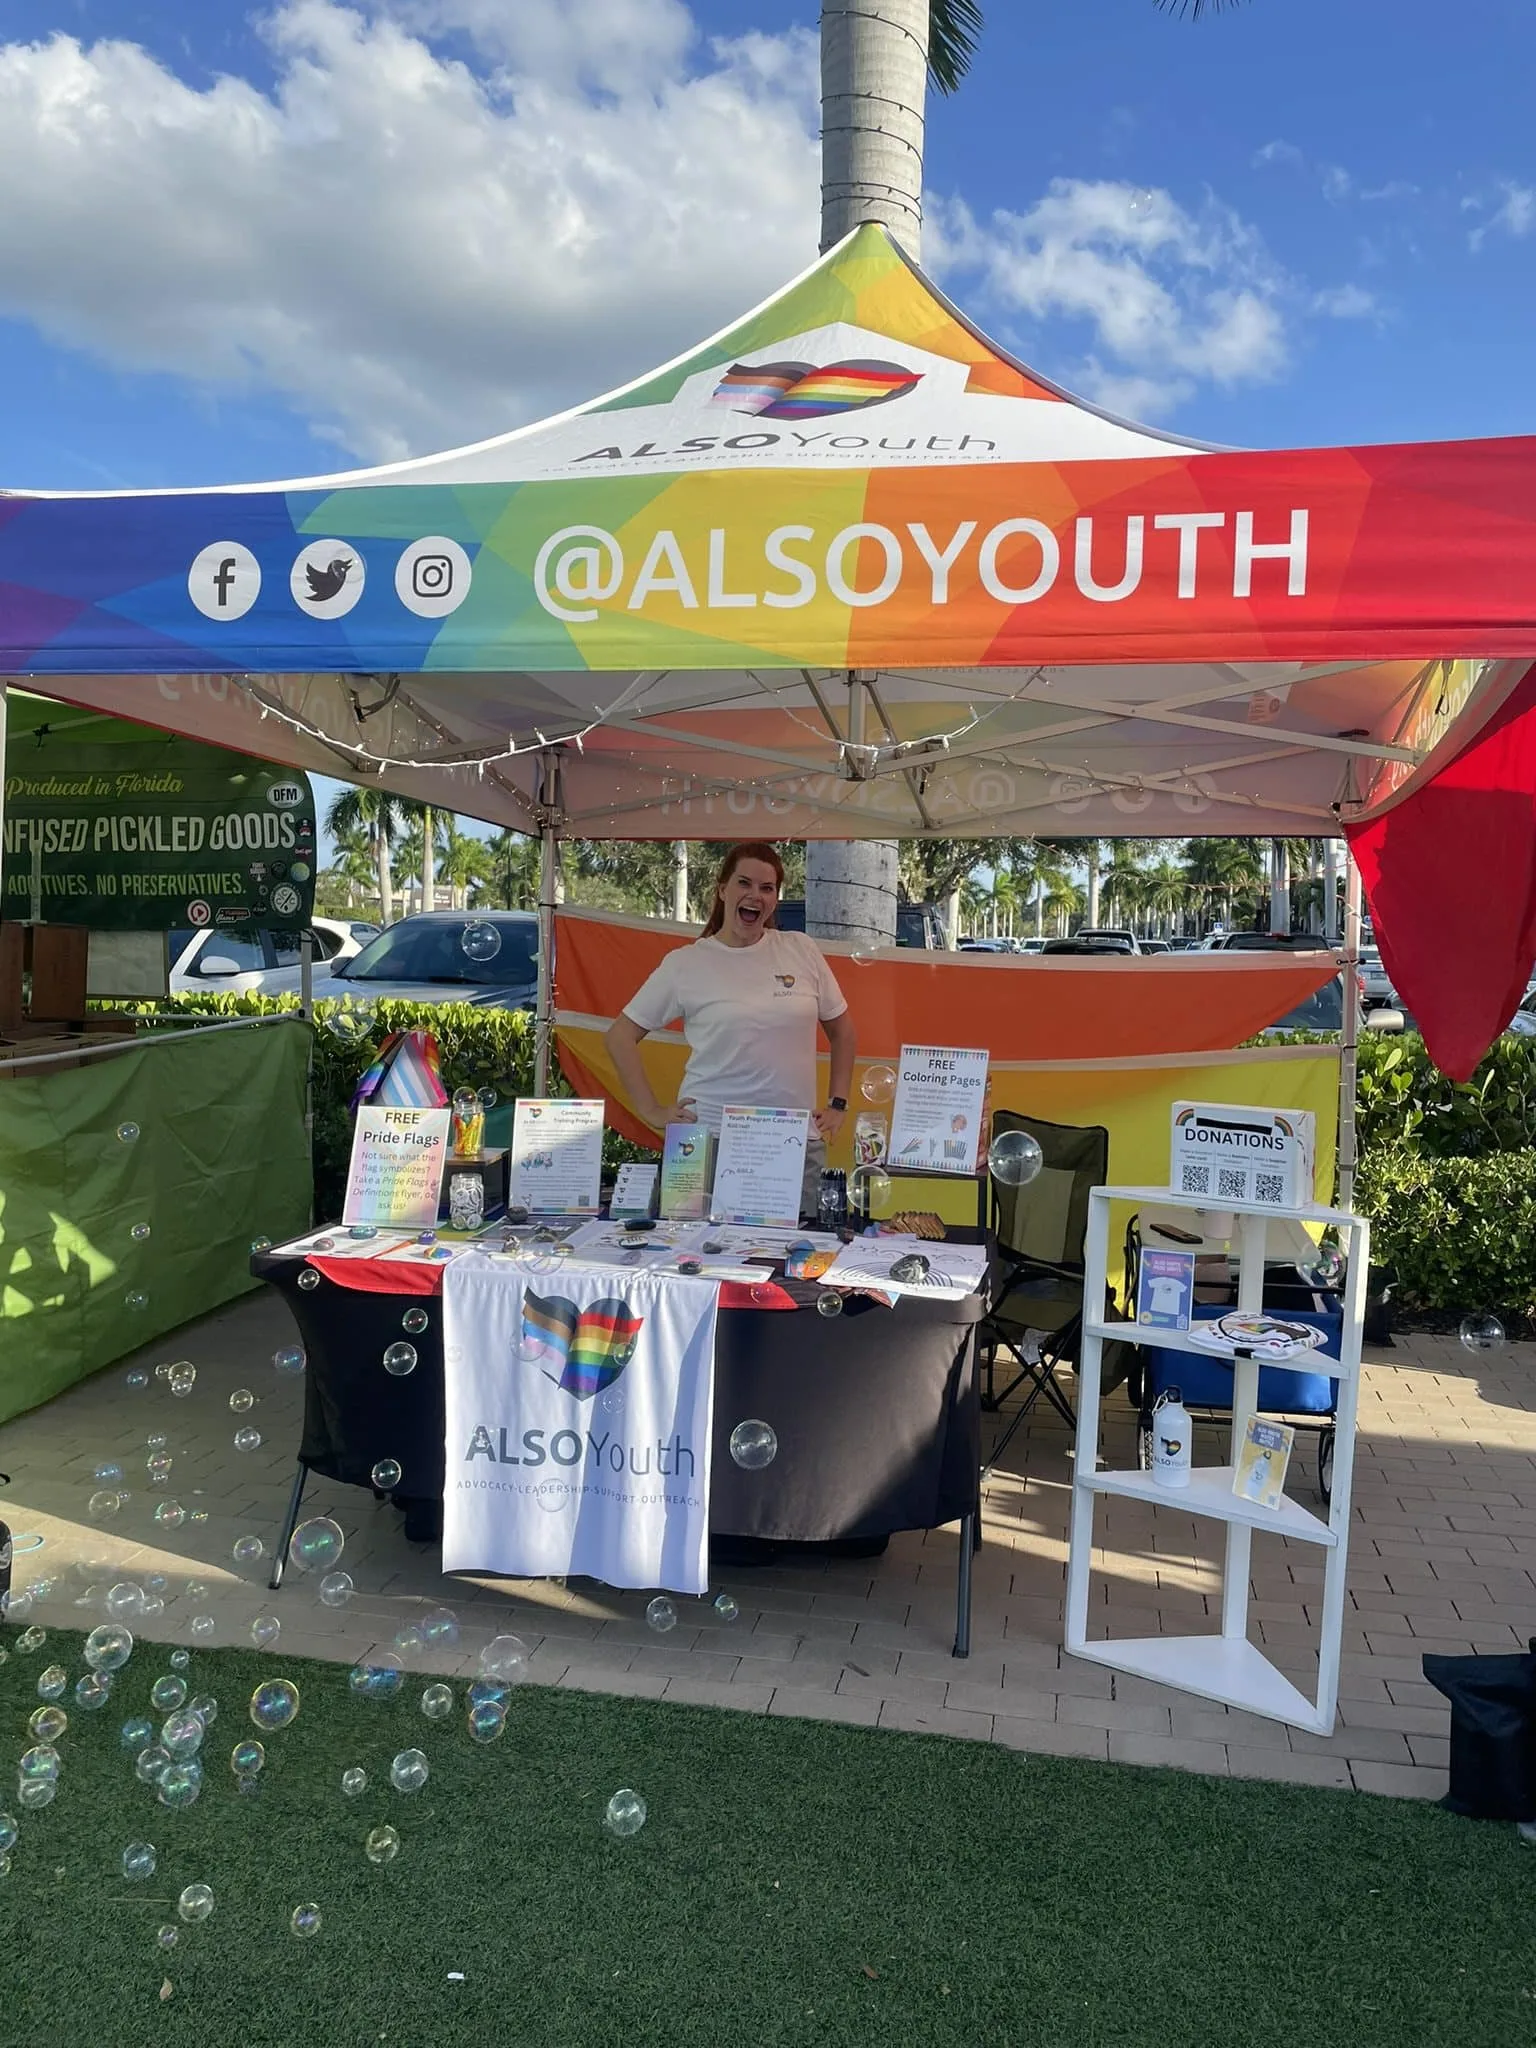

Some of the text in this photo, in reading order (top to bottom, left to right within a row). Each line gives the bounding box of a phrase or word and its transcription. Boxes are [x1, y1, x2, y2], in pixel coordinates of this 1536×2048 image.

[533, 509, 1309, 622] @ALSOYOUTH
[5, 772, 184, 800] Produced in Florida
[273, 787, 298, 801] DFM
[94, 816, 205, 852] PICKLED
[209, 812, 295, 850] GOODS
[97, 874, 117, 896] NO
[122, 873, 246, 896] PRESERVATIVES.
[928, 1059, 956, 1070] FREE
[903, 1072, 981, 1088] Coloring Pages
[384, 1112, 421, 1124] FREE
[363, 1131, 440, 1148] Pride Flags
[1185, 1128, 1284, 1150] DONATIONS
[361, 1151, 377, 1159] Not
[400, 1153, 420, 1161] what
[421, 1153, 436, 1161] the
[361, 1163, 431, 1174] flag symbolizes?
[354, 1175, 373, 1184] Take
[382, 1177, 405, 1186] Pride
[406, 1177, 429, 1188] Flags
[352, 1187, 400, 1197] Definitions
[378, 1202, 392, 1210] ask
